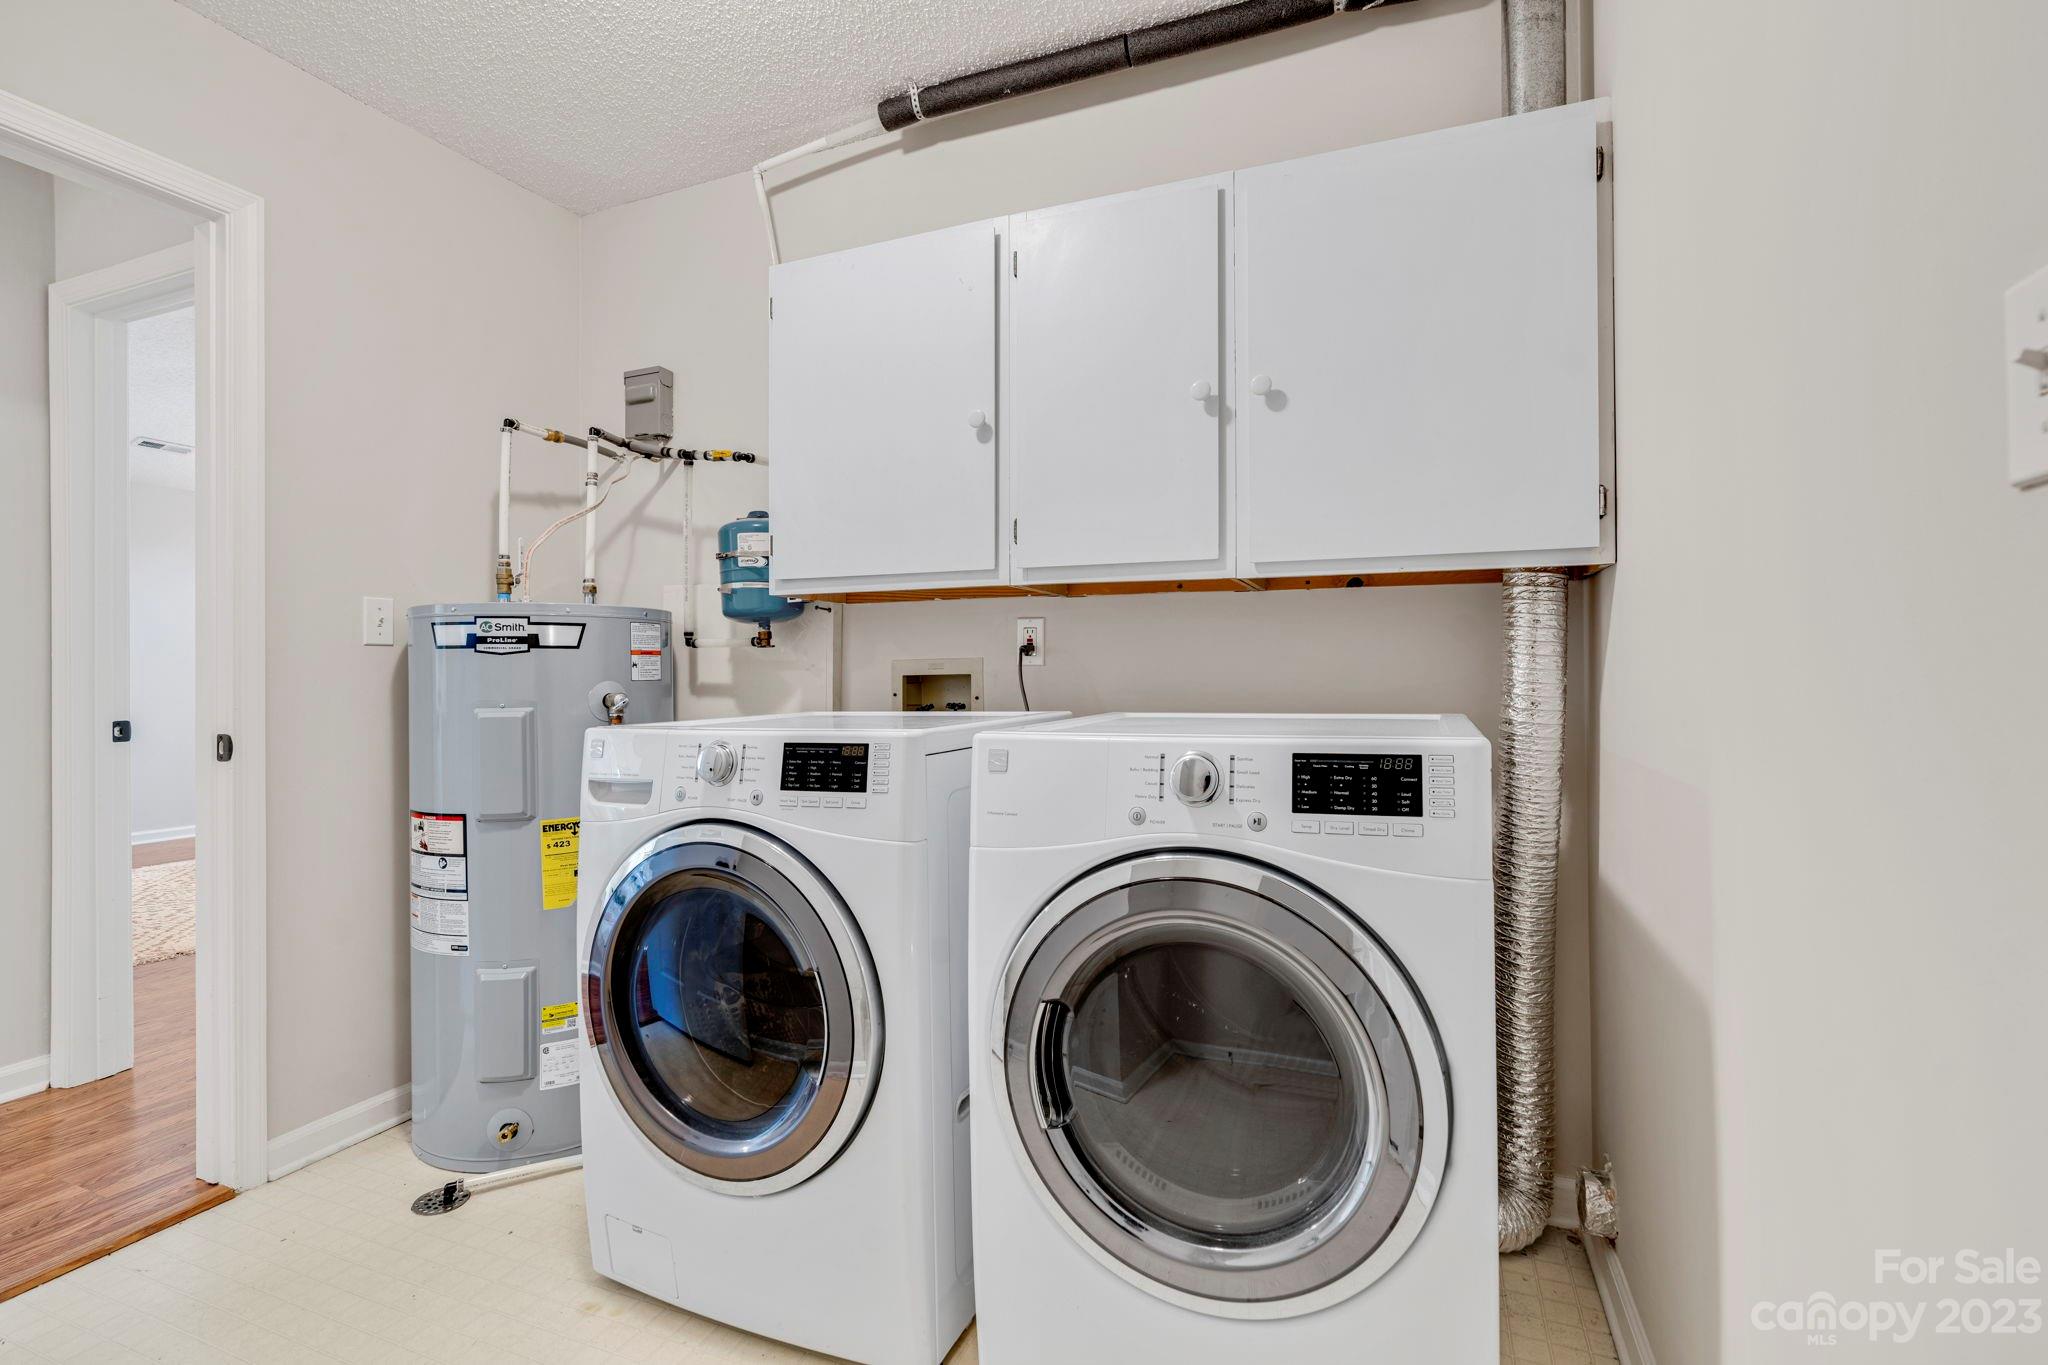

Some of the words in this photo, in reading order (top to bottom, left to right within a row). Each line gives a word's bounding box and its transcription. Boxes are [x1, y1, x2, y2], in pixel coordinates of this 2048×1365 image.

[494, 622, 526, 632] Smith
[1379, 757, 1414, 770] 18:88
[553, 840, 571, 848] 423
